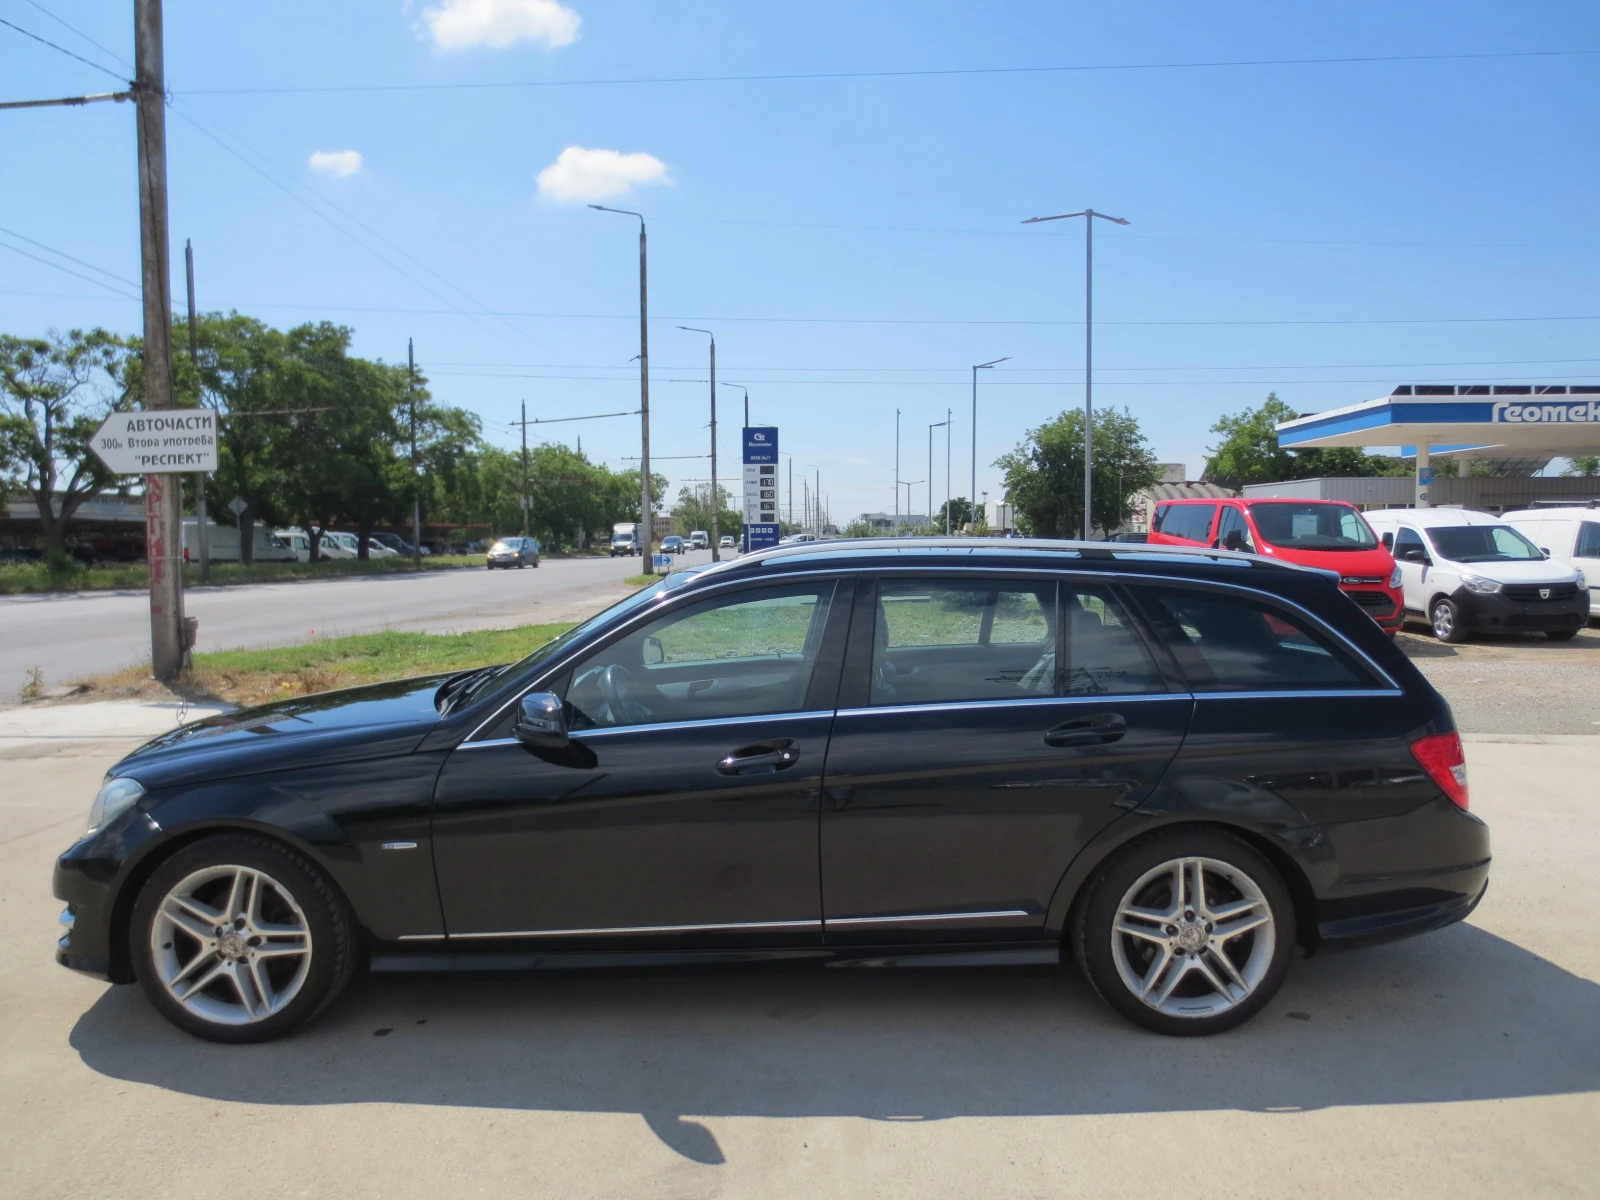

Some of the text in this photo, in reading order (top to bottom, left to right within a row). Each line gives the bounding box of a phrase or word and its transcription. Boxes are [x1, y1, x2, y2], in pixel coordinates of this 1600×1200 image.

[127, 416, 212, 432] АВТОЧАСТИ
[128, 437, 160, 448] Втора
[163, 434, 213, 448] употреба
